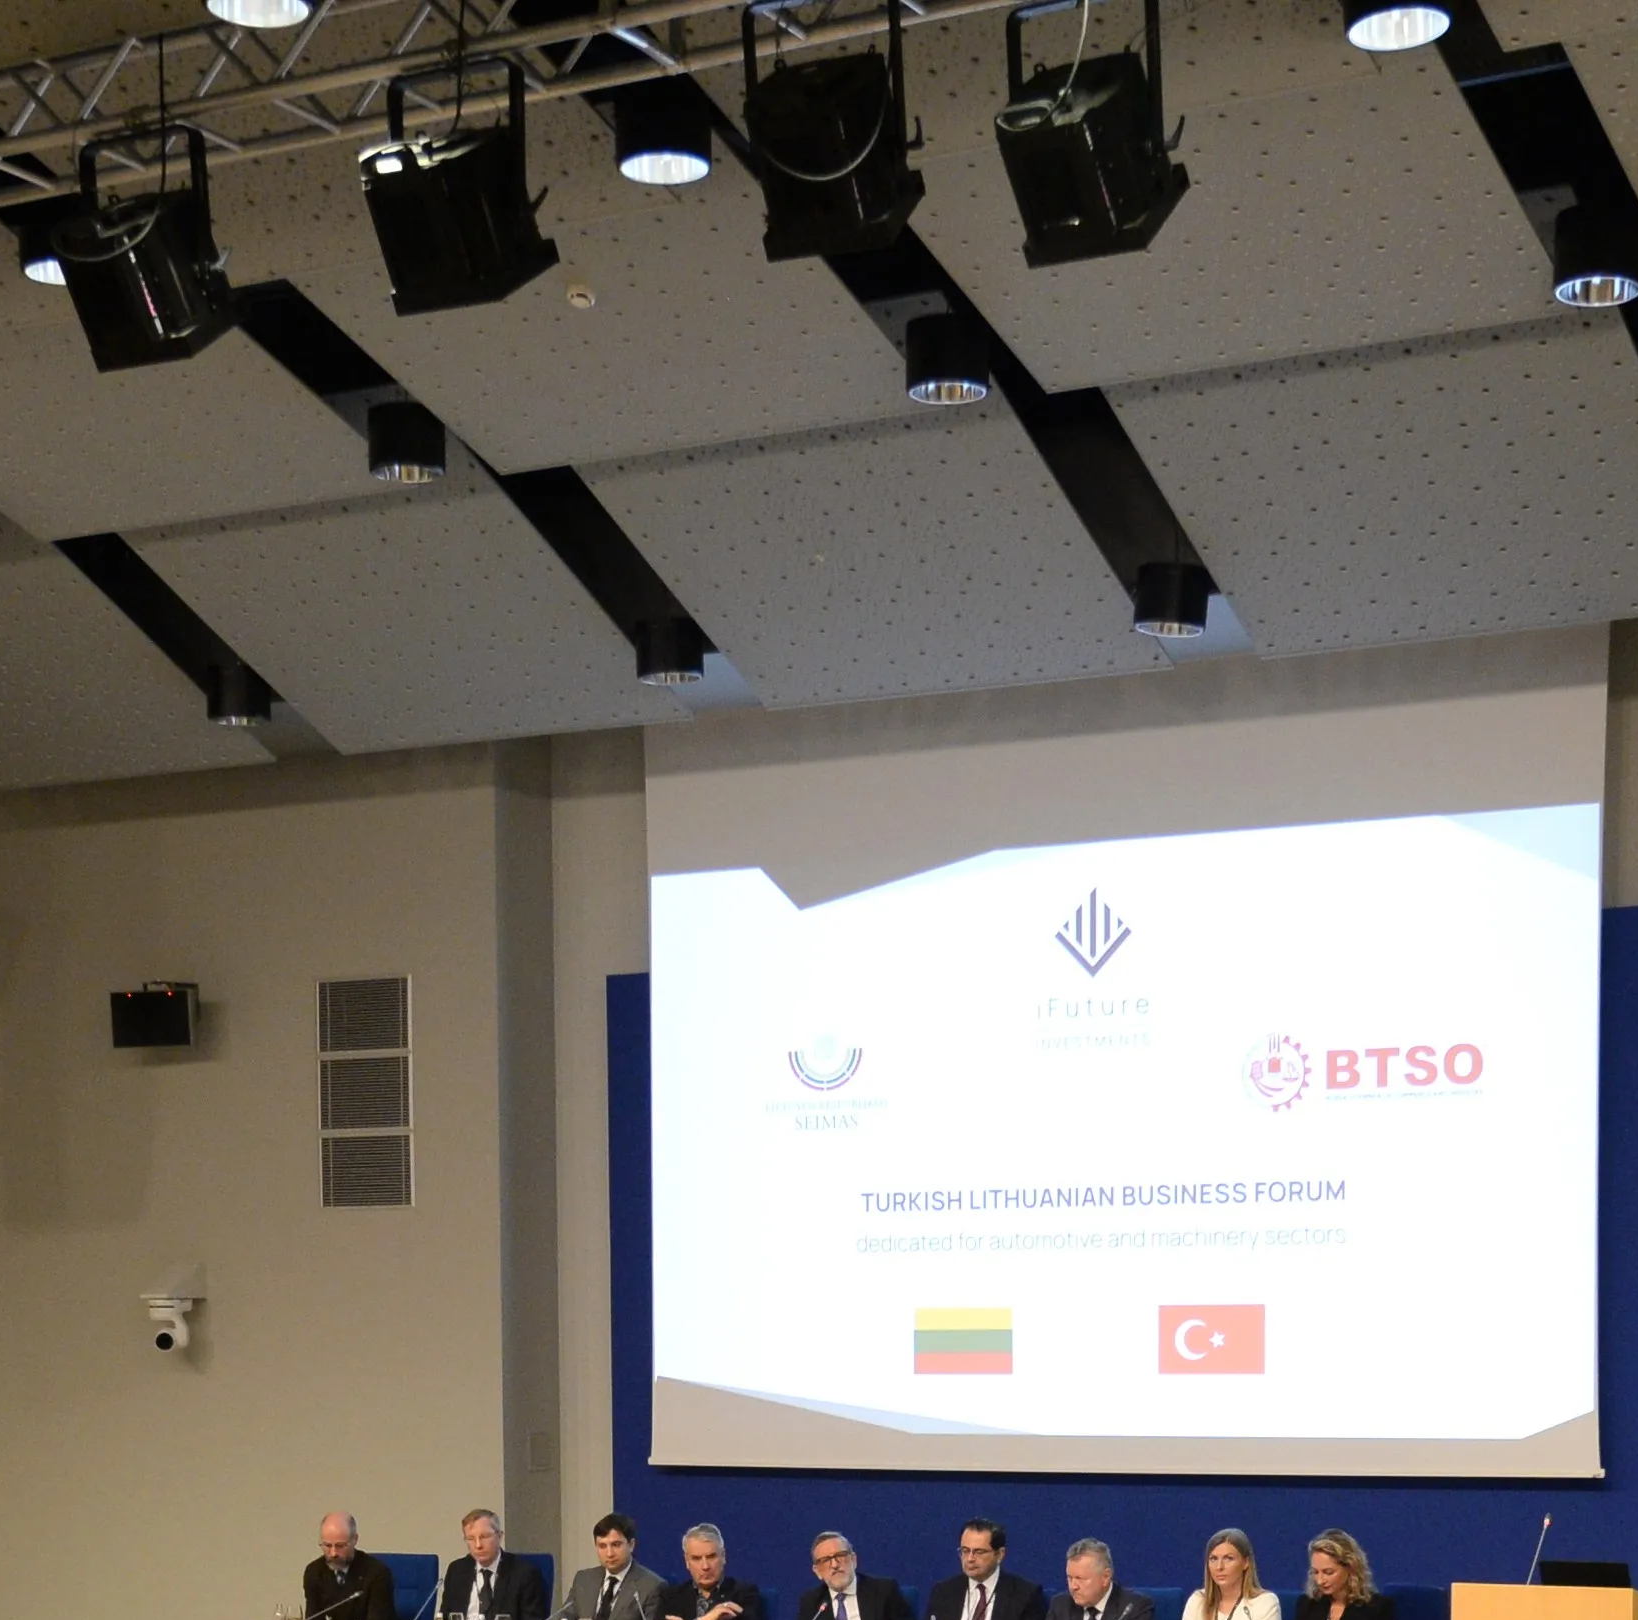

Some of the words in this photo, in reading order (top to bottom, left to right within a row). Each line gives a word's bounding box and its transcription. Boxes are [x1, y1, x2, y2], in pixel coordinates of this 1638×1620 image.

[1327, 1044, 1483, 1089] BTSO
[795, 1115, 858, 1130] SEIMAS
[861, 1191, 961, 1212] TURKISH
[971, 1187, 1113, 1209] LITHUANIAN
[1123, 1183, 1246, 1205] BUSINESS
[1256, 1181, 1344, 1202] FORUM
[857, 1235, 952, 1253] dedicated
[959, 1233, 983, 1250] for
[990, 1232, 1102, 1250] automotive
[1109, 1230, 1145, 1248] and
[1152, 1230, 1258, 1250] machinery
[1266, 1228, 1345, 1245] sectors
